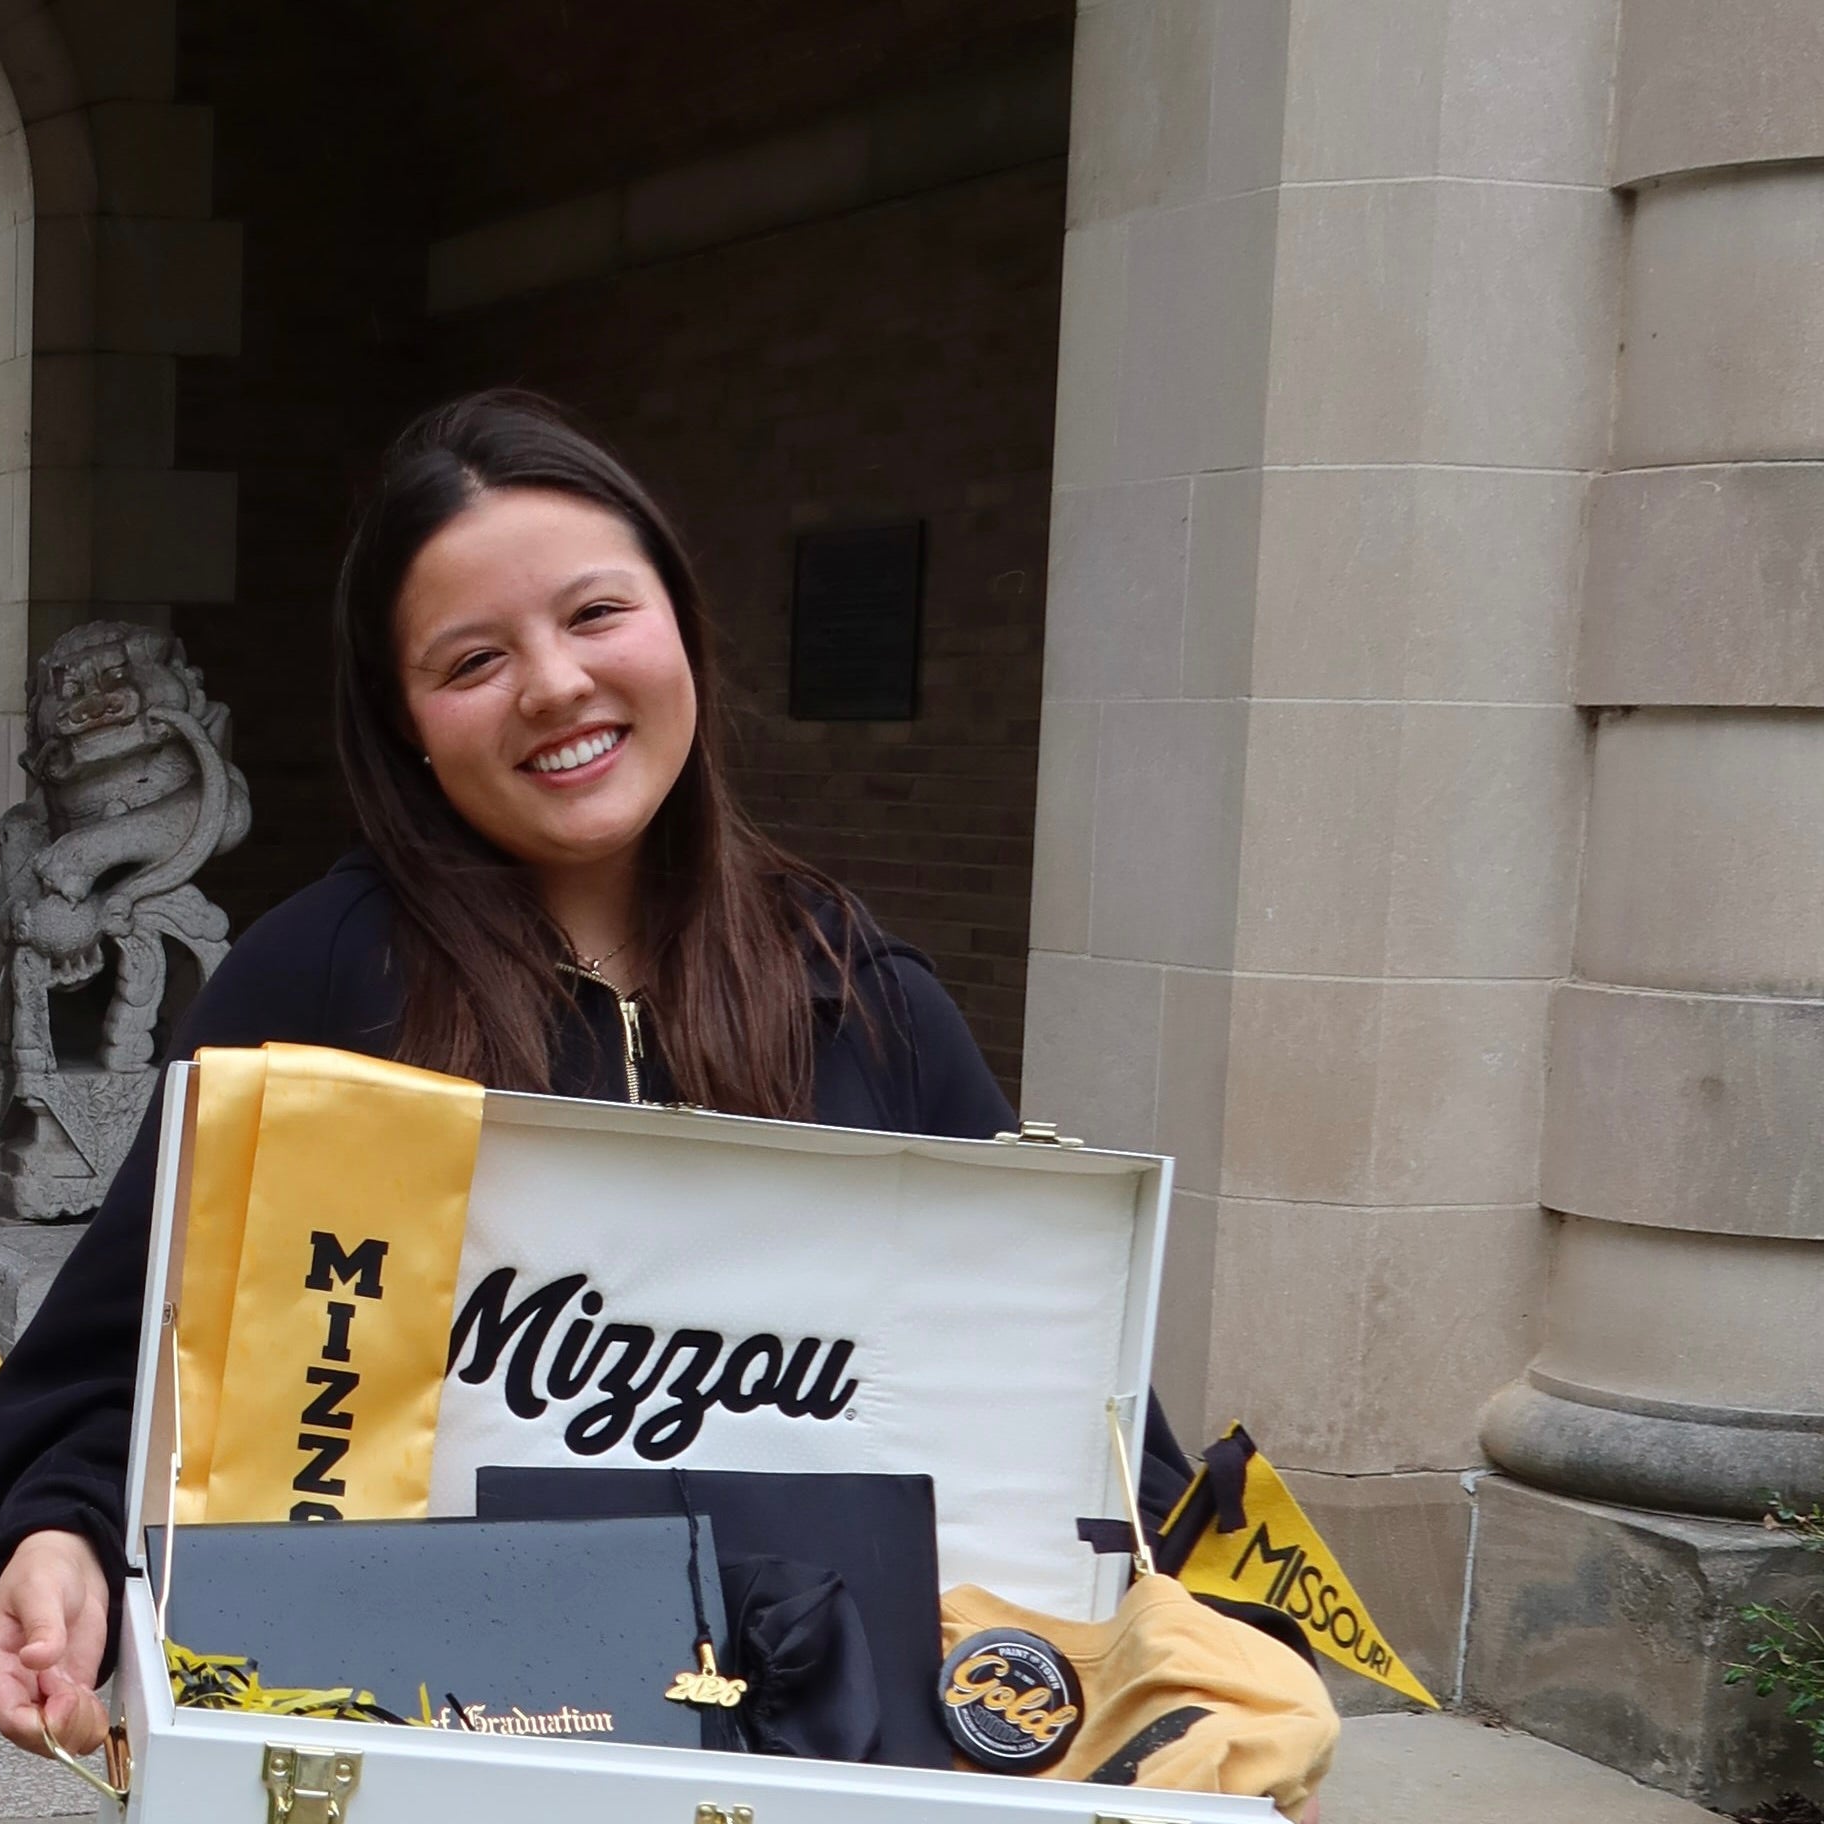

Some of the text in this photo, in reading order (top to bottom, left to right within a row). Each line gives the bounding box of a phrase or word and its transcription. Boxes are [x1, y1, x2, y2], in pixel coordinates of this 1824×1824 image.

[289, 1230, 389, 1521] MIZZ
[444, 1267, 858, 1461] Mizzou
[1230, 1521, 1393, 1677] MISSOURI
[460, 1704, 614, 1735] Graduation
[665, 1672, 747, 1707] 2026
[945, 1654, 1078, 1742] Gold
